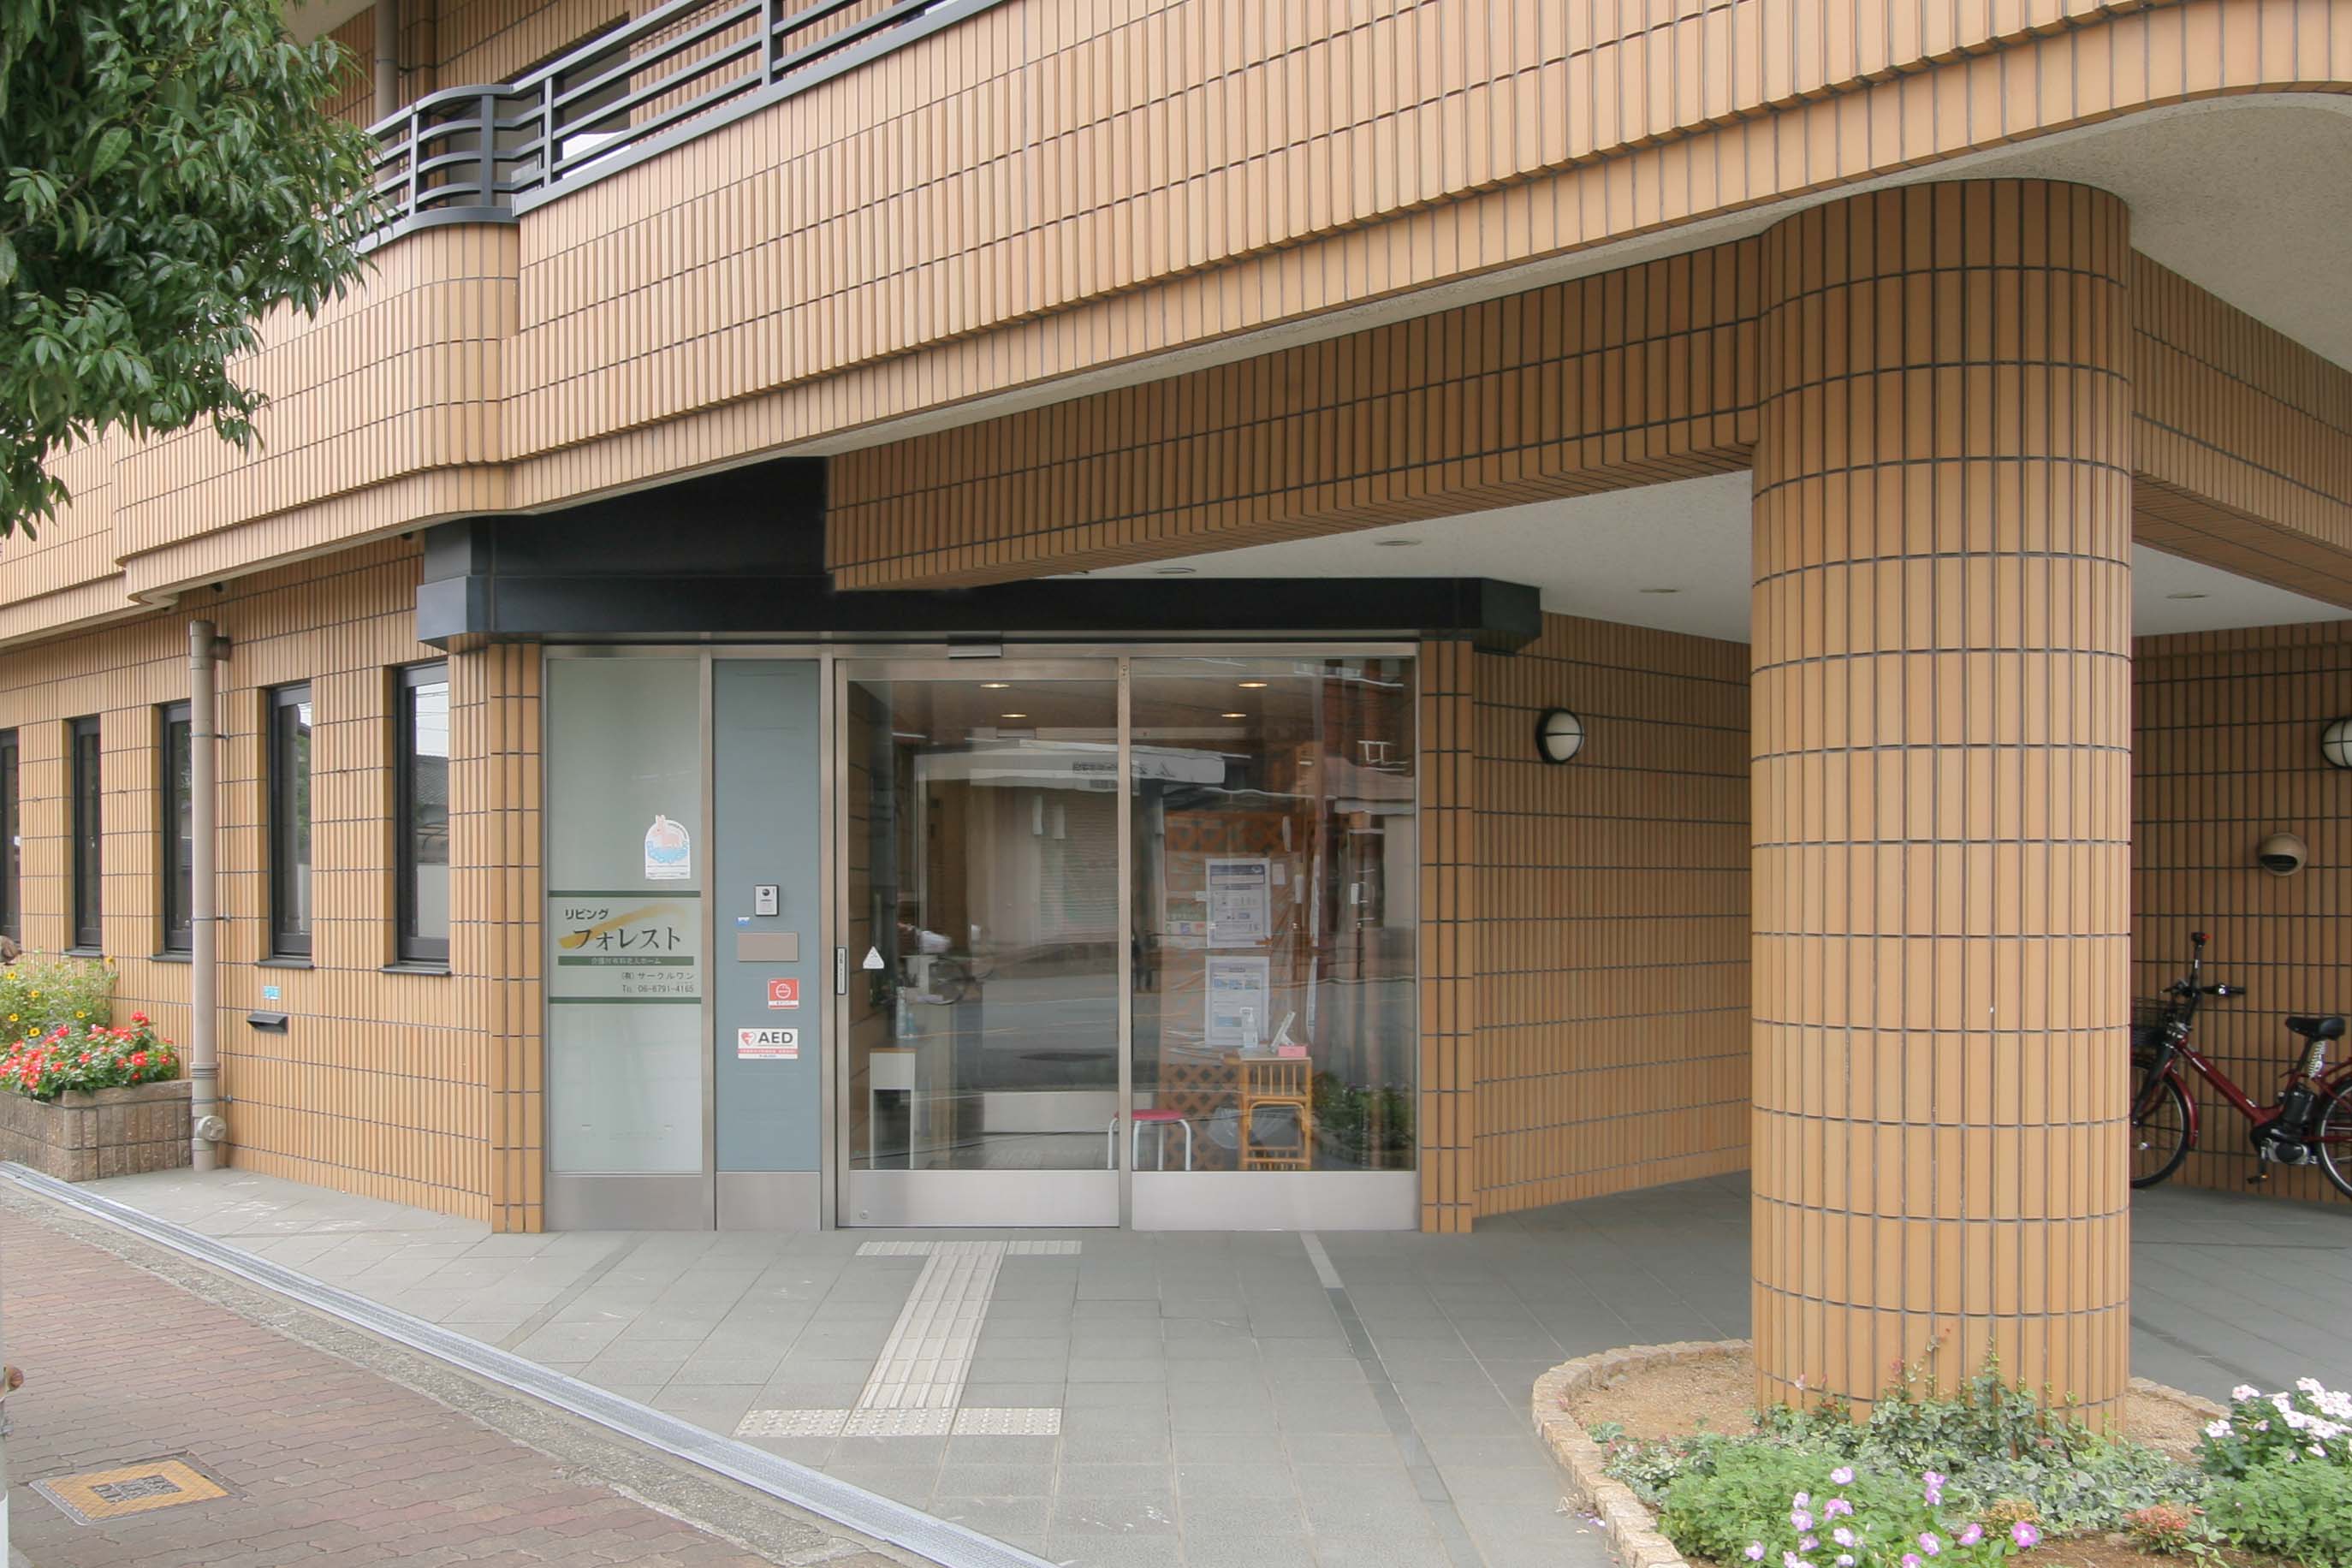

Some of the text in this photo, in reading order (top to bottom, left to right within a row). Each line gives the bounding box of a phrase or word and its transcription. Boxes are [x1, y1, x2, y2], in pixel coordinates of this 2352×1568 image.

[565, 908, 609, 920] リビング
[573, 927, 680, 950] フォレスト
[758, 1032, 793, 1043] AED
